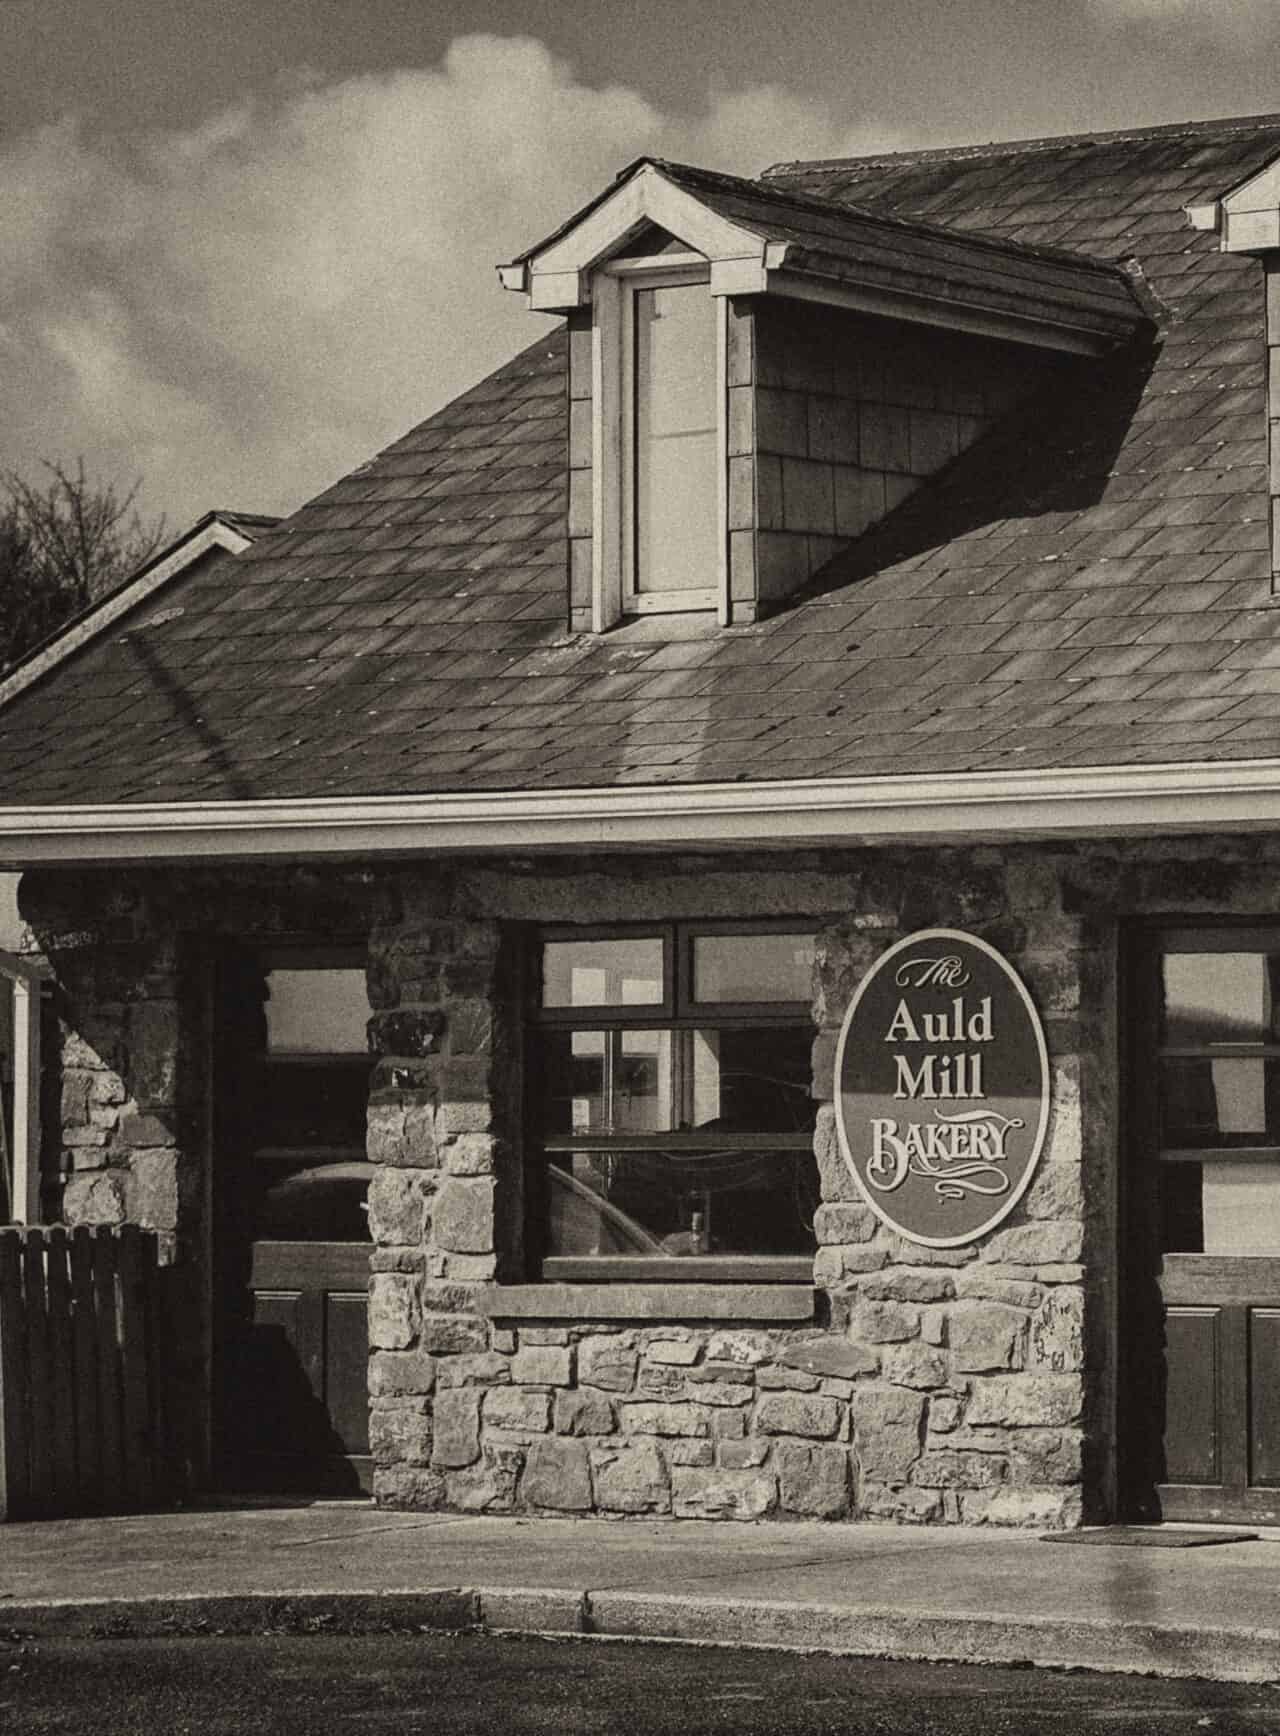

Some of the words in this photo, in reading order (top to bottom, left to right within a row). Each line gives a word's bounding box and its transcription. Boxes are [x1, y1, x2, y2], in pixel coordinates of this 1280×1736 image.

[896, 955, 970, 987] The
[885, 997, 994, 1042] Auld
[893, 1053, 985, 1099] Mill
[866, 1109, 1024, 1194] BAKERY
